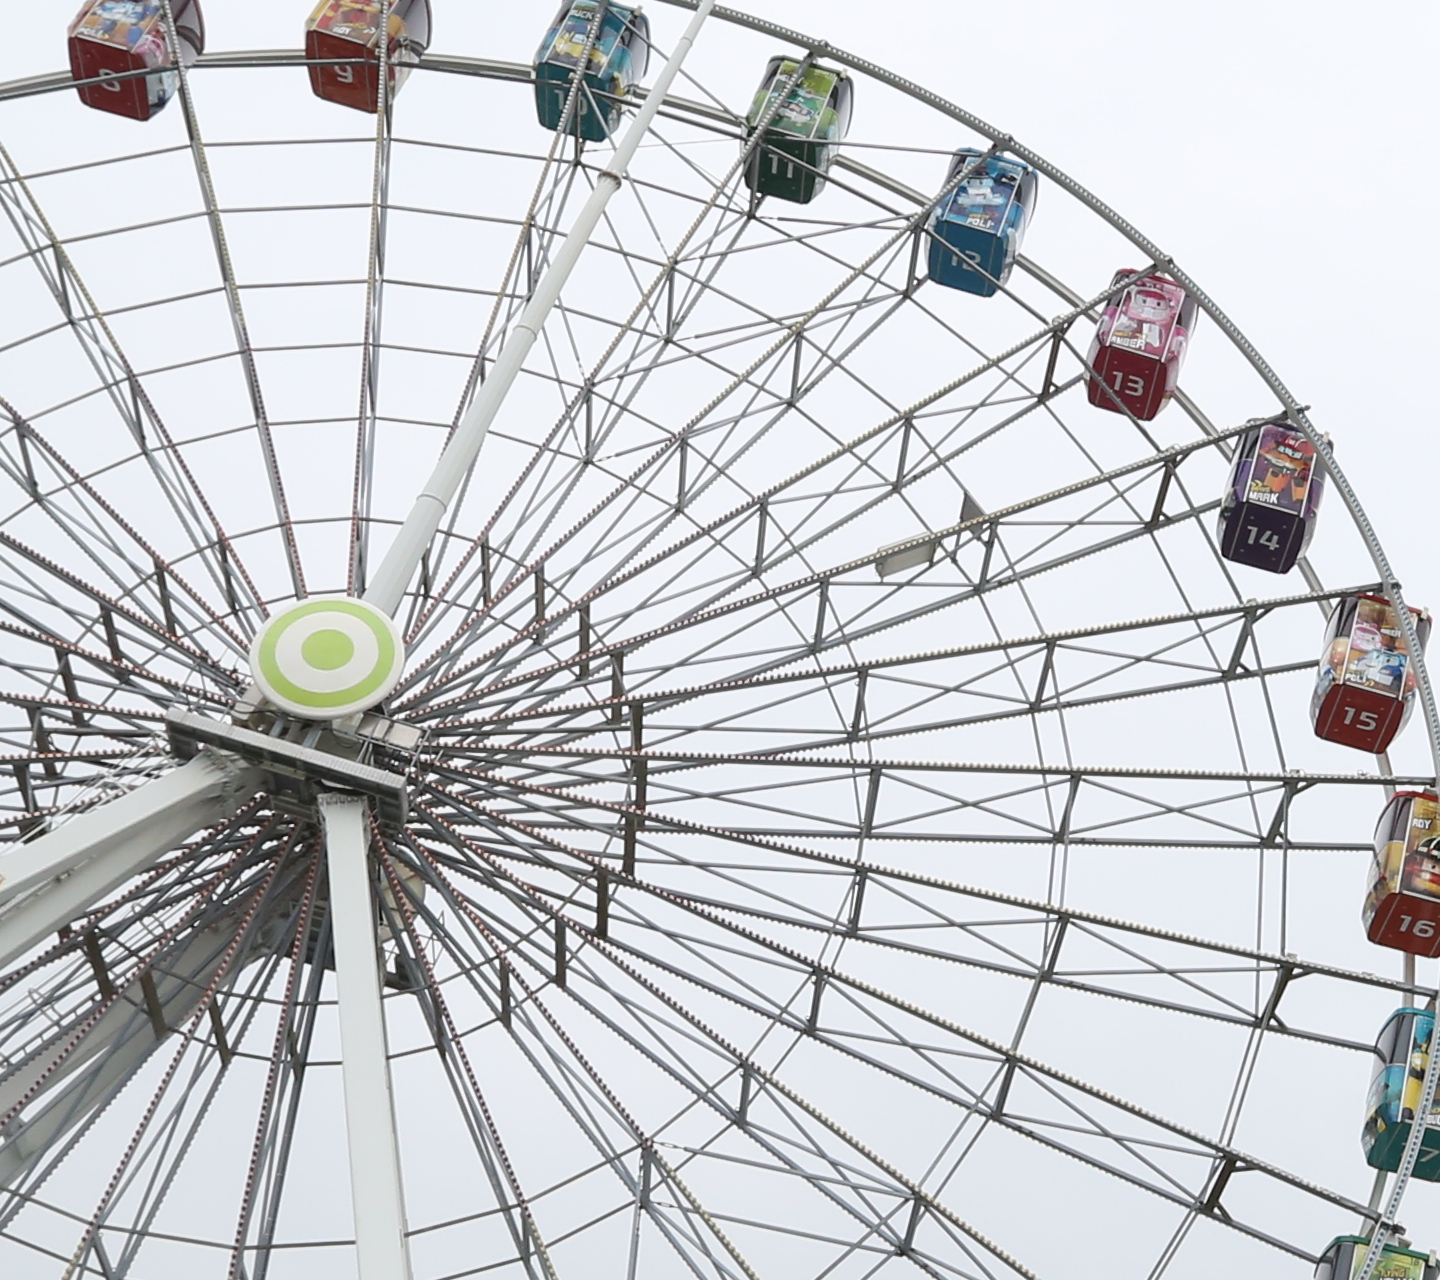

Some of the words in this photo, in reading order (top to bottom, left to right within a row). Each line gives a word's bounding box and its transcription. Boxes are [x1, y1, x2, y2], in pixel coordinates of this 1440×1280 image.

[333, 64, 353, 83] 9
[1112, 371, 1144, 396] 13
[1248, 490, 1279, 504] MARK
[1247, 525, 1280, 551] 14
[1344, 706, 1379, 731] 15
[1411, 818, 1432, 830] ROY
[1398, 914, 1436, 938] 16
